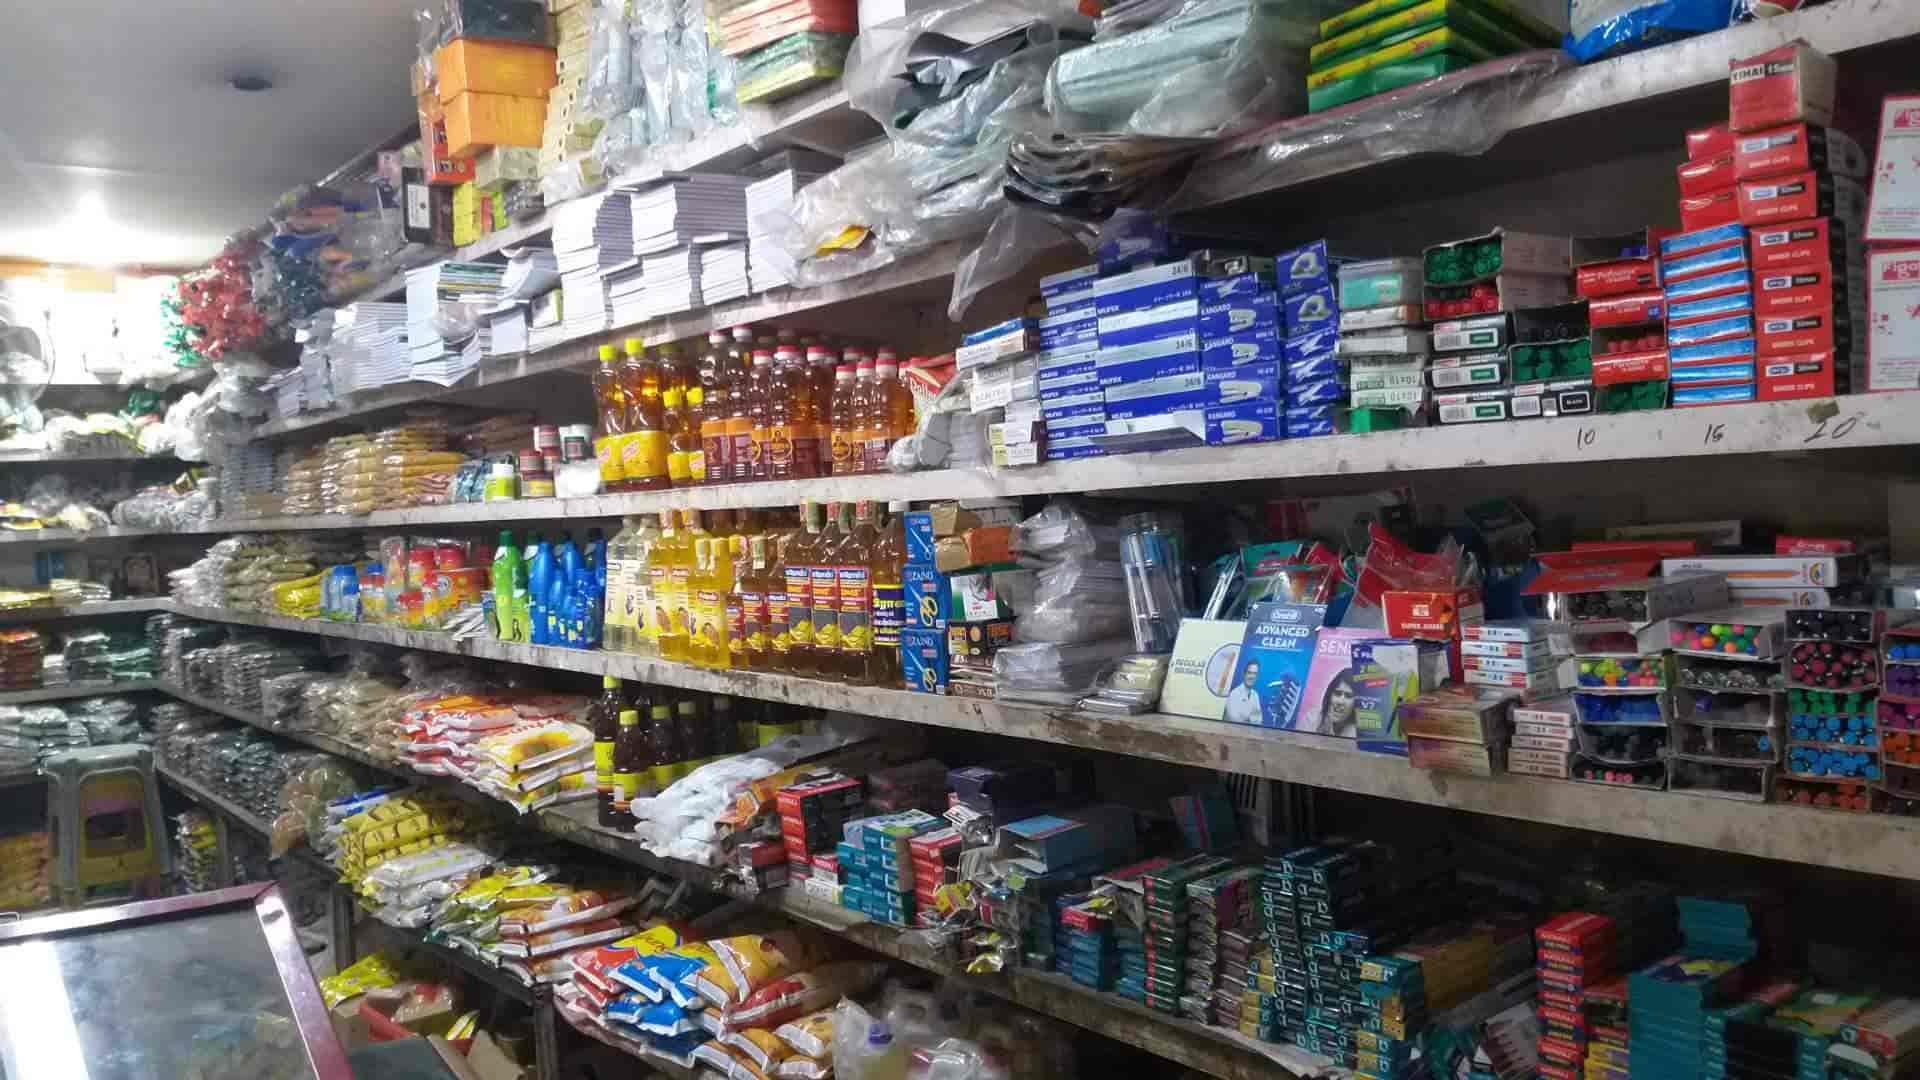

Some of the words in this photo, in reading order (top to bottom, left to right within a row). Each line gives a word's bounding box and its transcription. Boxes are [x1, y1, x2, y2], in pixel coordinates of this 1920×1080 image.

[1577, 427, 1596, 451] 10
[1255, 625, 1311, 638] ADVANCED
[1261, 637, 1297, 649] CLEAN
[1319, 639, 1352, 656] SEN
